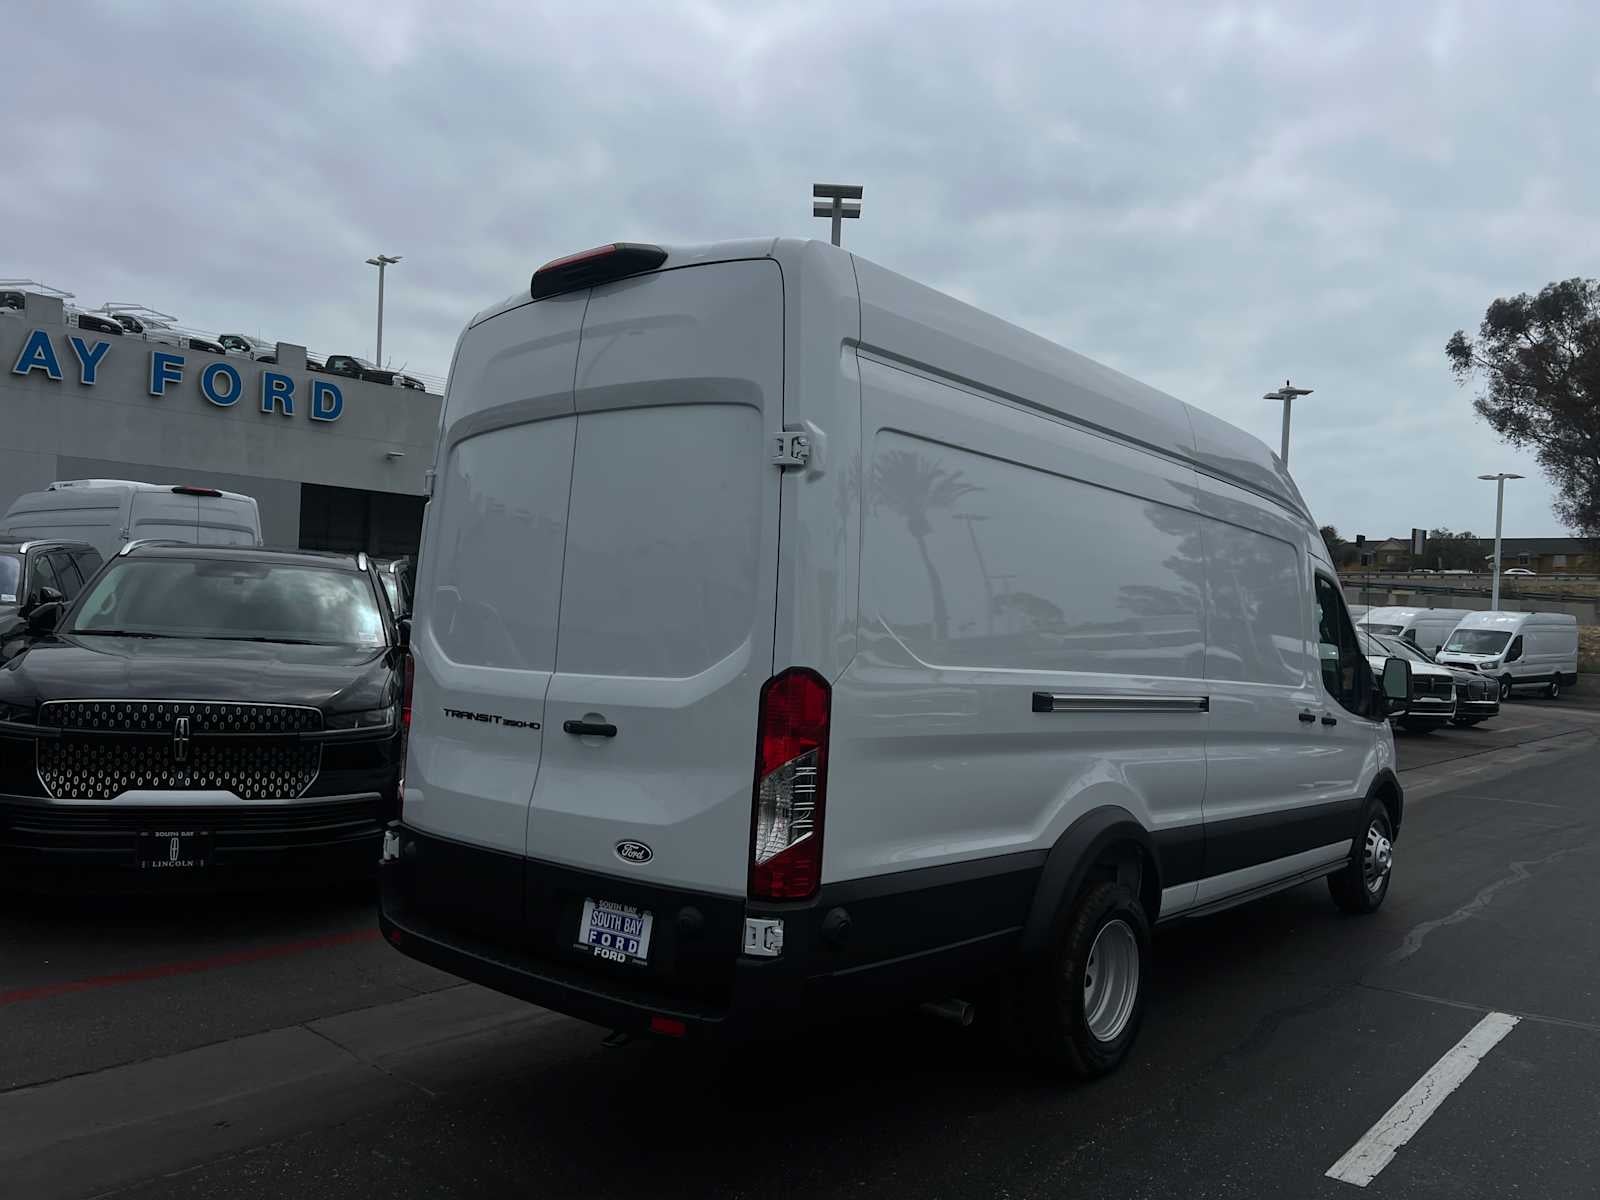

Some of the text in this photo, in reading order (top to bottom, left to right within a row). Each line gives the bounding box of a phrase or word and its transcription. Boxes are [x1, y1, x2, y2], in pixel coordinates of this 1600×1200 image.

[12, 328, 345, 423] AY FORD
[443, 708, 503, 724] TRANSIT
[152, 860, 193, 868] LINCOLN
[592, 910, 642, 936] SOUTH BAY
[589, 931, 638, 954] FORD
[594, 946, 626, 963] FORD
